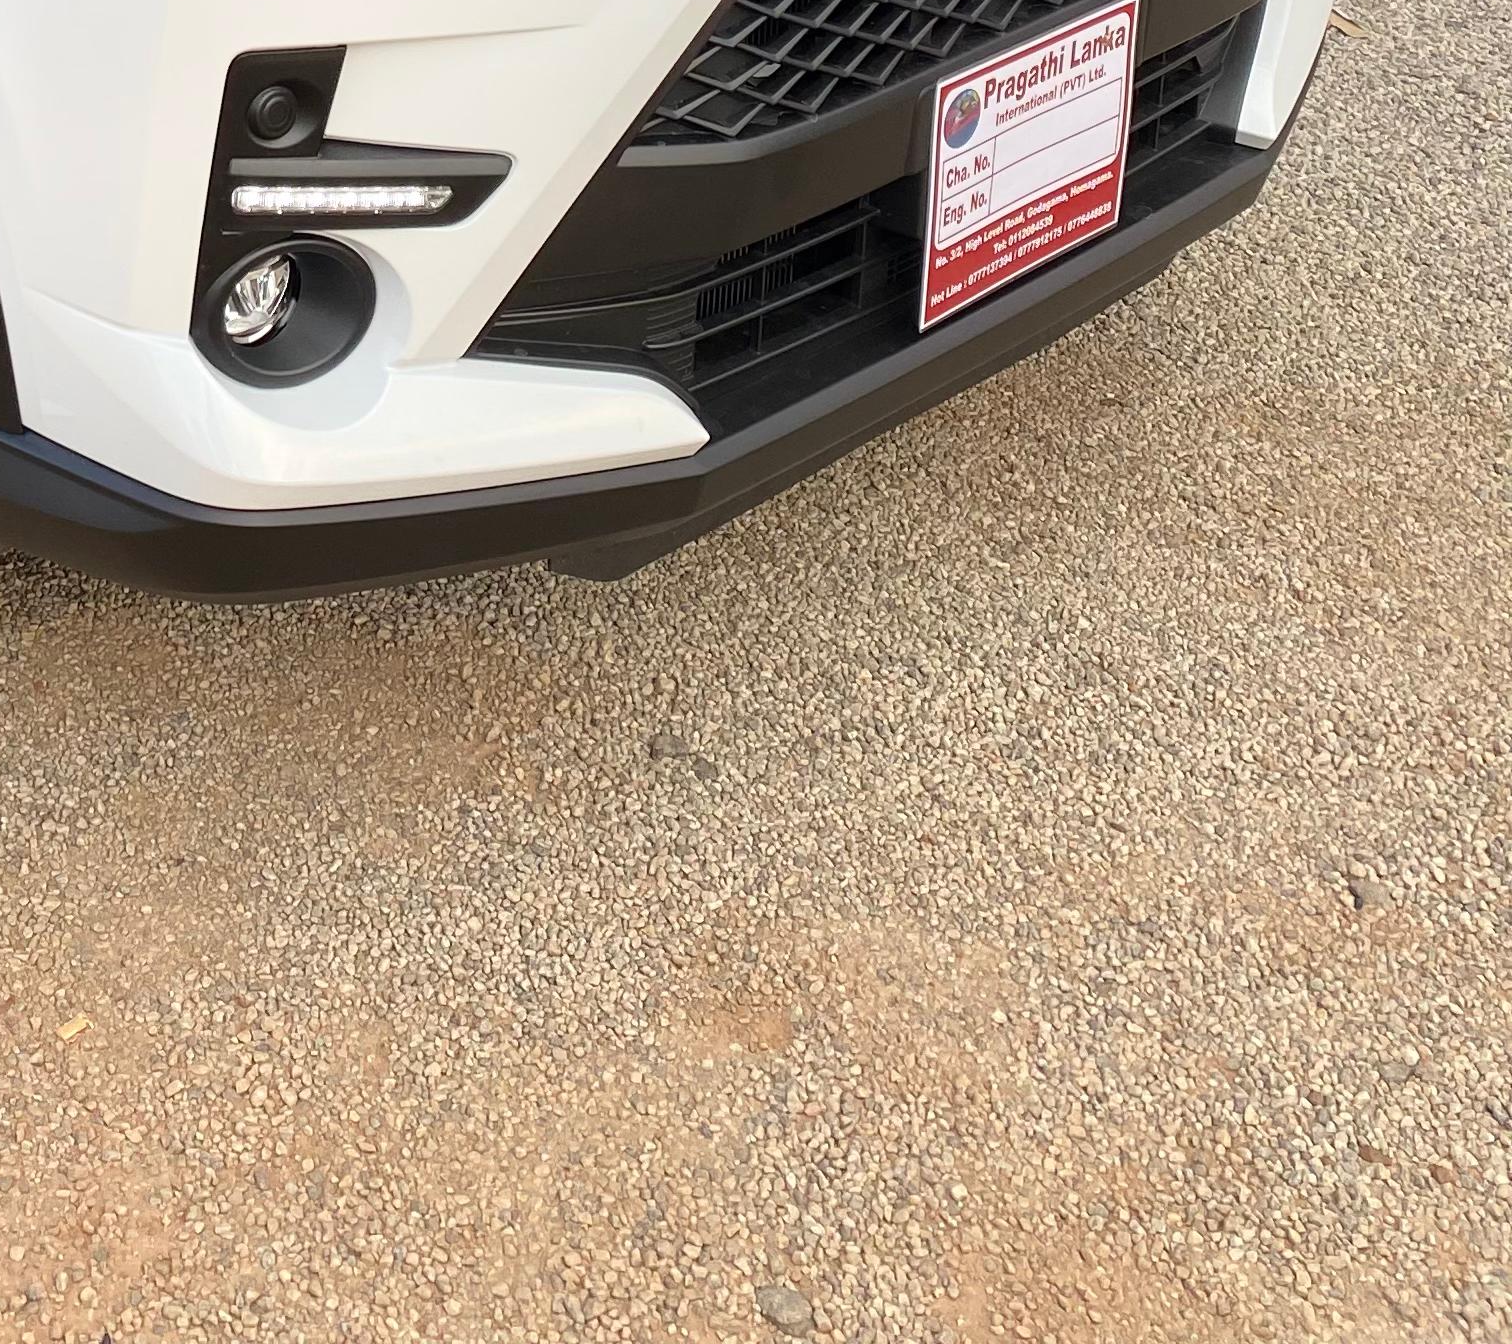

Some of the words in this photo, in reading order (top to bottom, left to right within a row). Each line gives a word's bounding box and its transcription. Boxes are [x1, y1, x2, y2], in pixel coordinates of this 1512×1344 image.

[983, 45, 1065, 110] Pragathi
[1069, 25, 1126, 69] Lanka
[995, 87, 1058, 127] International
[1059, 72, 1086, 100] (PVT)
[1088, 64, 1107, 83] Ltd.
[946, 165, 970, 189] Cha.
[973, 154, 991, 176] No.
[943, 206, 967, 227] Eng.
[970, 191, 988, 212] No.
[983, 223, 1004, 243] Level
